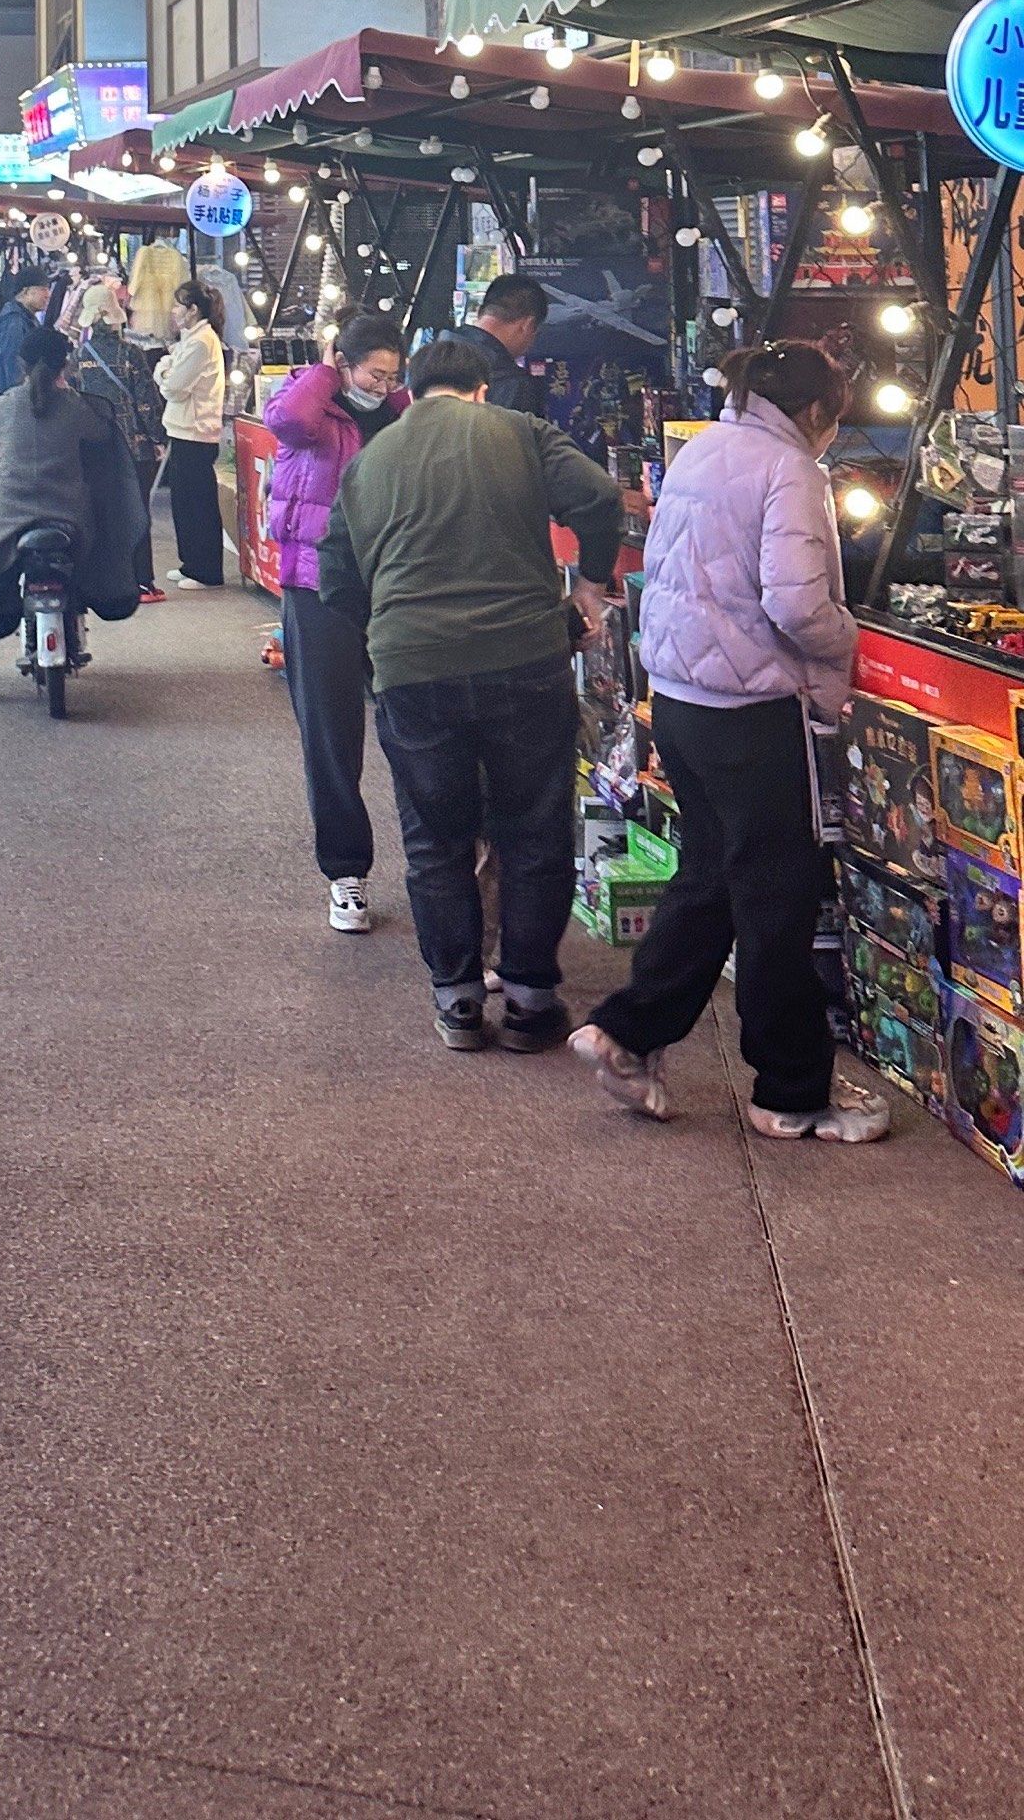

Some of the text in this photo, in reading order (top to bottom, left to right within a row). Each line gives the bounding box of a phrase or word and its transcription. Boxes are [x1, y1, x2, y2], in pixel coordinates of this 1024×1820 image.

[974, 77, 1024, 130] 儿
[194, 204, 243, 225] 手机贴膜
